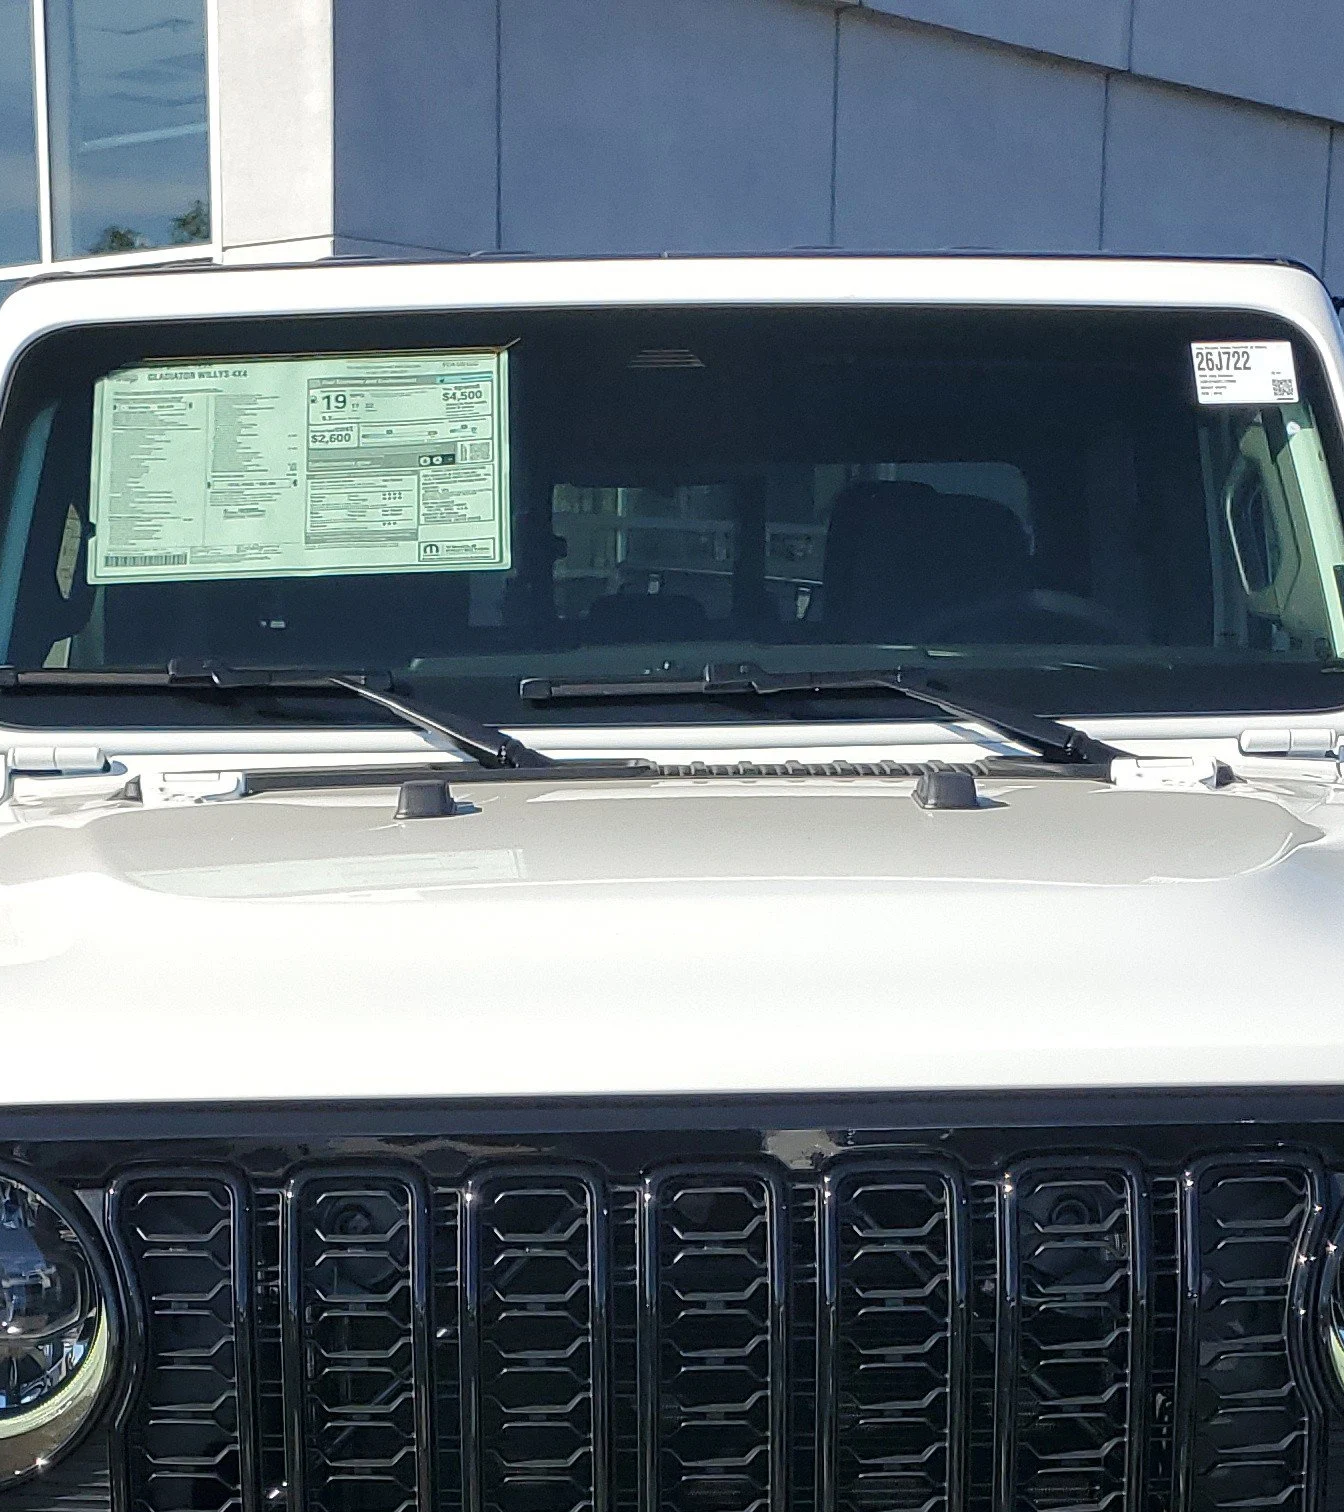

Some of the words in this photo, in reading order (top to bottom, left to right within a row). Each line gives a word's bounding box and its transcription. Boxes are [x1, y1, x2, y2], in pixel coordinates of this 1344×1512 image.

[1196, 350, 1252, 371] 26J722
[322, 393, 347, 411] 19
[442, 390, 483, 402] $4,500
[311, 432, 352, 444] $2,600
